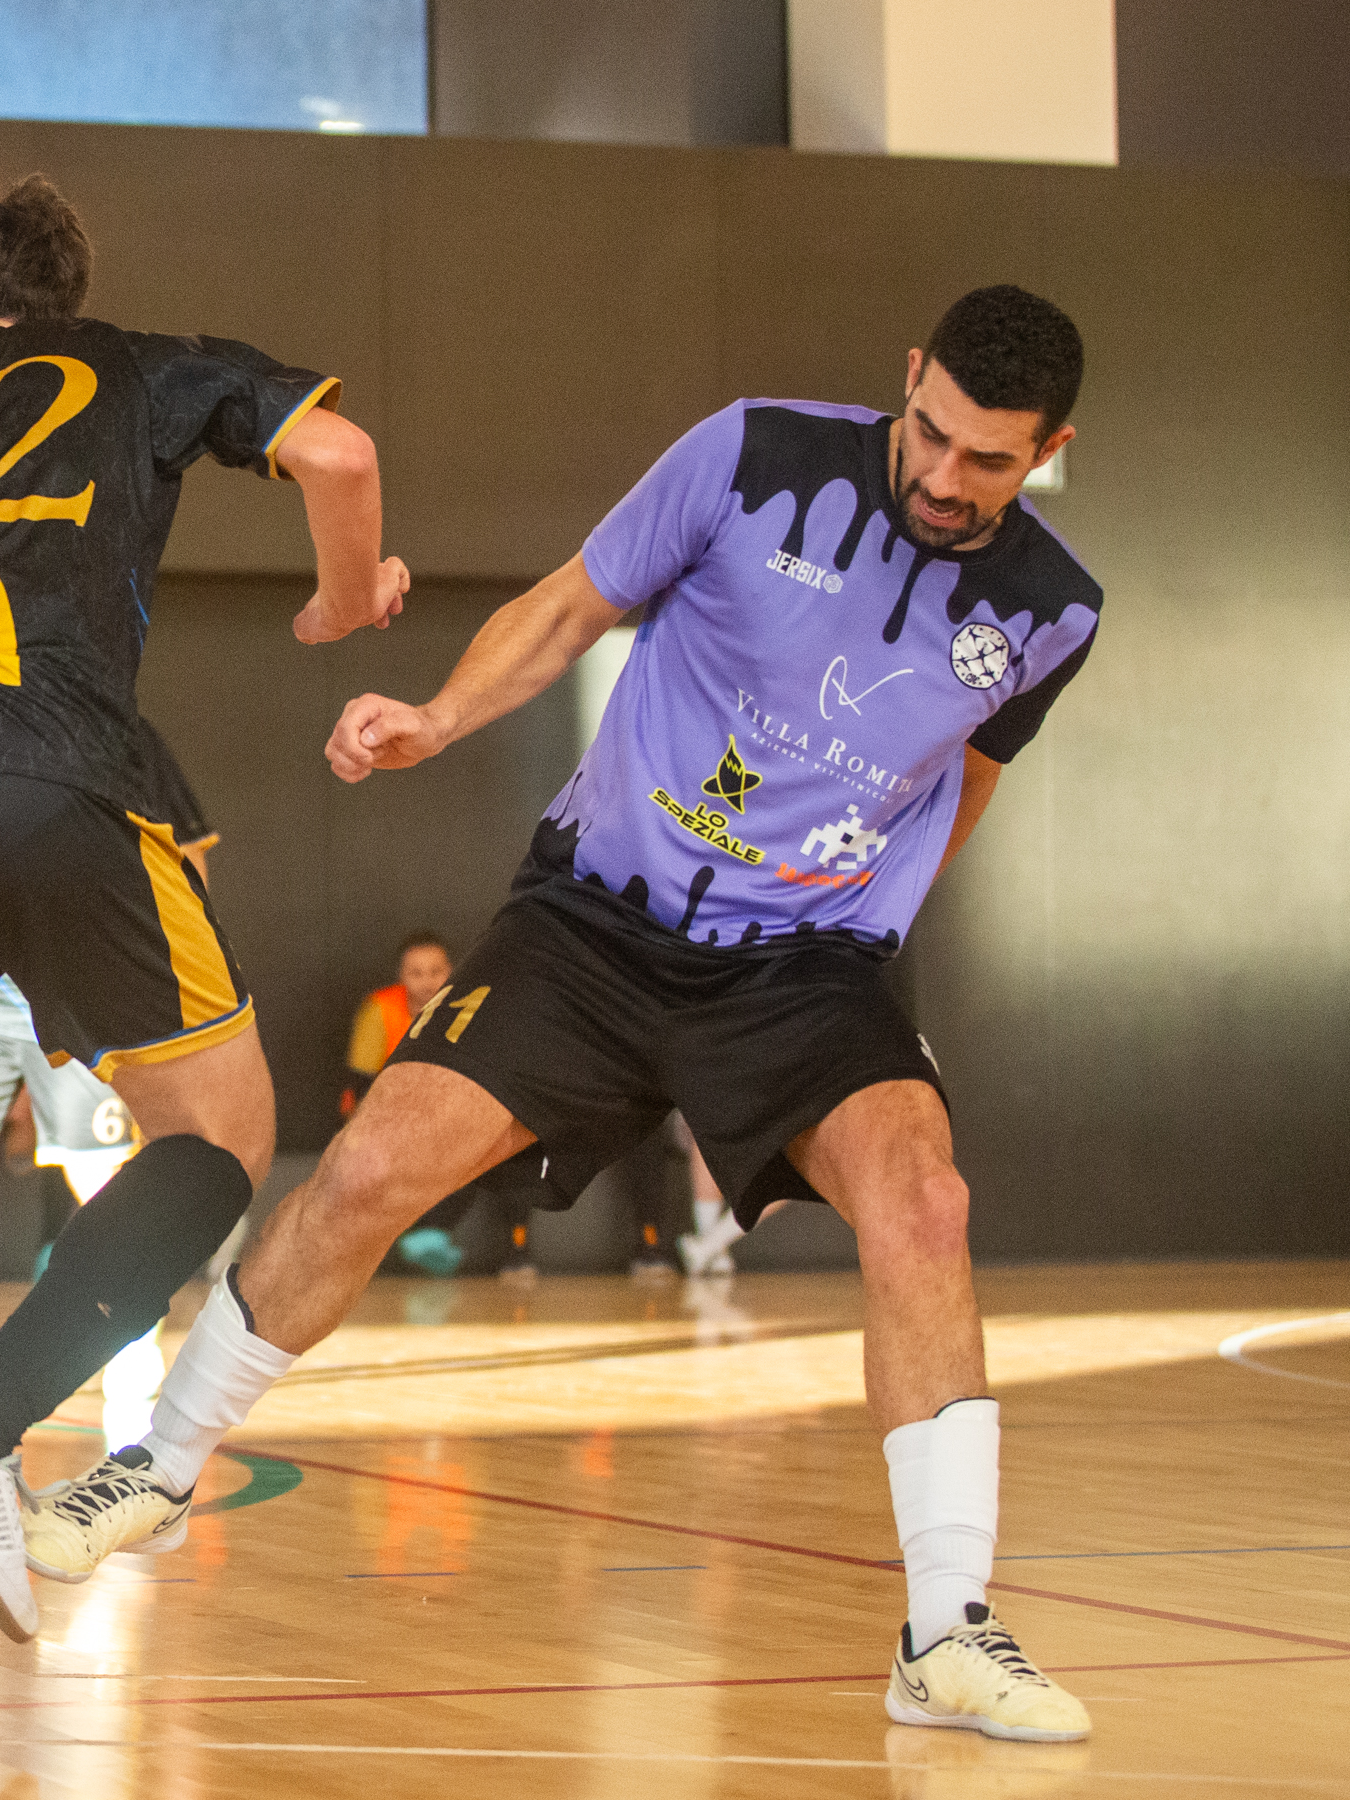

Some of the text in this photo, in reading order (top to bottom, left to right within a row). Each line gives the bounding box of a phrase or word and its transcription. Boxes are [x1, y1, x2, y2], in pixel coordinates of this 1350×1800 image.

[766, 549, 828, 589] JERSIX
[737, 688, 809, 751] VILLA
[654, 790, 760, 863] SPEZIALE
[695, 804, 726, 828] LO
[409, 984, 491, 1043] 11
[92, 1098, 125, 1144] 6
